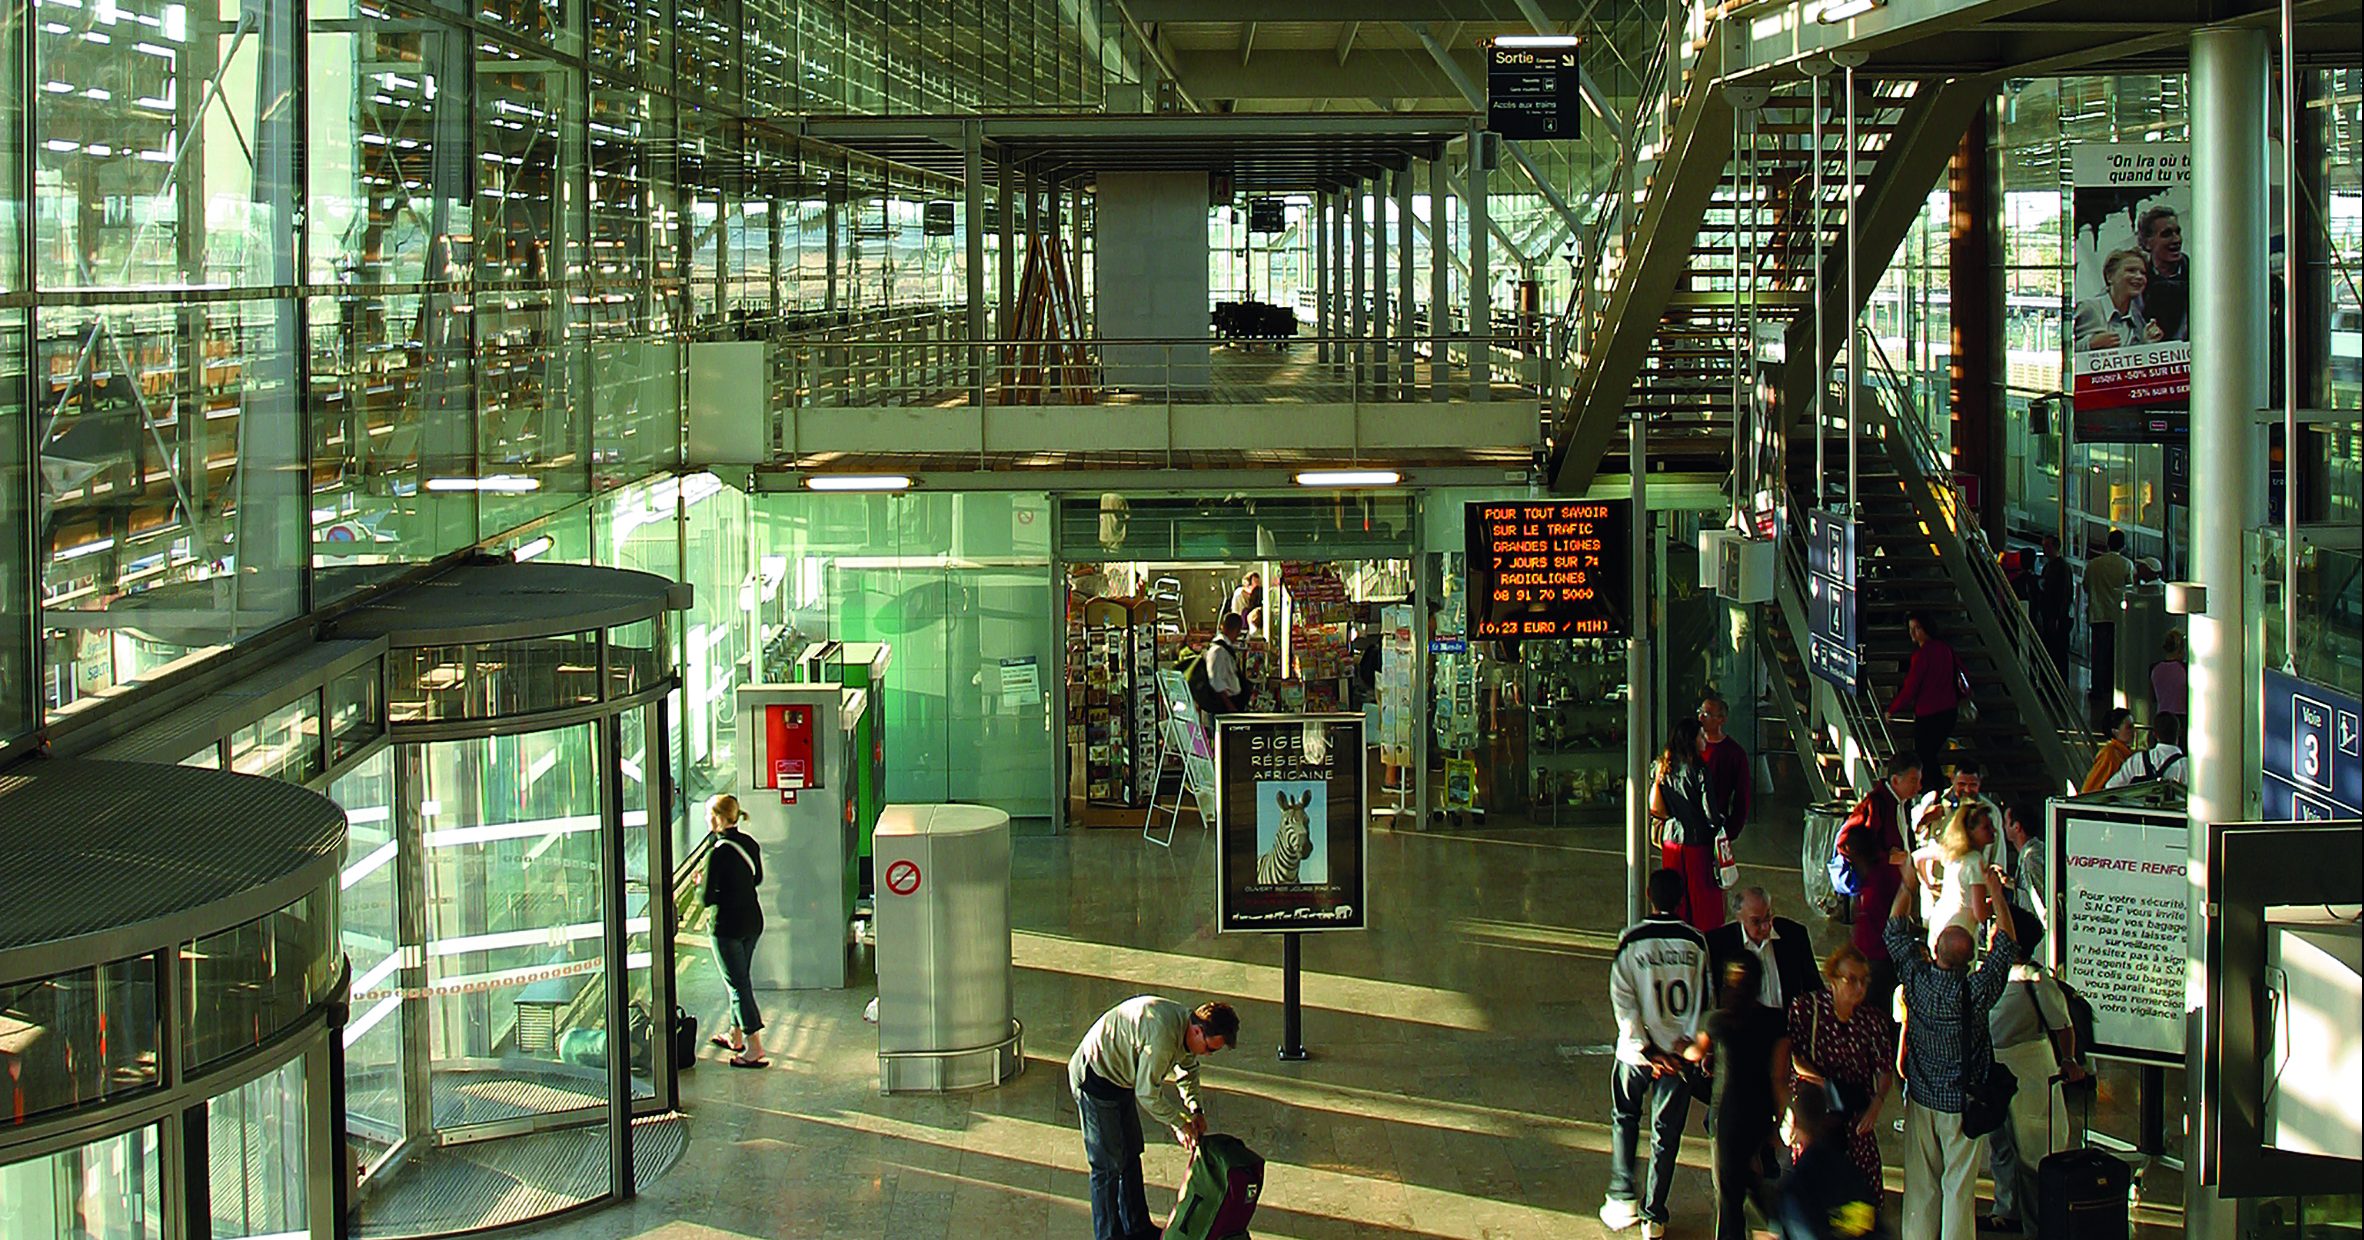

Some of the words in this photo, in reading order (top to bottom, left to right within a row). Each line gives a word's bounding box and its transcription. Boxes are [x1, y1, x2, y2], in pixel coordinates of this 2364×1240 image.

[1496, 51, 1534, 64] Sortie
[1535, 101, 1557, 109] trains
[2159, 153, 2177, 167] où
[2109, 169, 2153, 184] quand
[2157, 169, 2172, 181] tu
[2089, 353, 2143, 372] CARTE
[2149, 367, 2168, 378] SUR
[2170, 365, 2181, 375] LE
[1485, 508, 1517, 521] POUR
[1523, 507, 1555, 520] TOUT
[1561, 507, 1609, 519] SAVOIR
[1493, 524, 1517, 536] SUR
[1523, 524, 1539, 536] LE
[1547, 523, 1594, 535] TRAFIC
[1493, 540, 1548, 552] GRANDES
[1553, 539, 1601, 552] LIGNES
[1493, 557, 1502, 569] 7
[1509, 556, 1548, 568] JOURS
[1554, 556, 1578, 568] SUR
[1831, 546, 1840, 573] 3
[1500, 572, 1586, 585] RADIOLIGNES
[1493, 589, 1509, 601] 08
[1516, 589, 1531, 601] 91
[1539, 589, 1555, 601] 70
[1562, 588, 1594, 600] 5000
[1832, 607, 1840, 631] 4
[1524, 622, 1555, 634] EURO
[2302, 705, 2322, 727] Voie
[1251, 736, 1334, 750] SIGEN
[1251, 753, 1334, 767] RÉSERE
[2304, 733, 2319, 776] 3
[1252, 770, 1334, 780] AFRICAINE
[2066, 855, 2137, 872] VIGIPIRATE
[2141, 862, 2187, 877] RENFO
[2079, 889, 2105, 901] Pour
[2108, 894, 2137, 904] votre
[2071, 912, 2121, 925] surveiller
[2123, 918, 2144, 928] vos
[2126, 907, 2152, 918] vous
[2155, 909, 2185, 921] invite
[2072, 922, 2079, 932] à
[2082, 924, 2096, 933] ne
[2098, 926, 2118, 936] pas
[2121, 928, 2137, 938] les
[2141, 930, 2177, 942] laisser
[2105, 938, 2169, 952] surveillance
[2088, 946, 2127, 959] hésitez
[2128, 951, 2149, 962] pas
[2152, 952, 2159, 962] à
[2073, 958, 2093, 966] aux
[2096, 959, 2132, 971] agents
[2135, 961, 2150, 971] de
[2152, 963, 2162, 973] la
[2072, 966, 2095, 976] tout
[2097, 968, 2122, 980] colis
[2125, 972, 2140, 982] ou
[2142, 973, 2182, 987] bagage
[2084, 979, 2110, 990] vous
[1654, 979, 1689, 1018] 10
[2077, 989, 2098, 999] ous
[2101, 993, 2128, 1003] vous
[2099, 1003, 2128, 1013] votre
